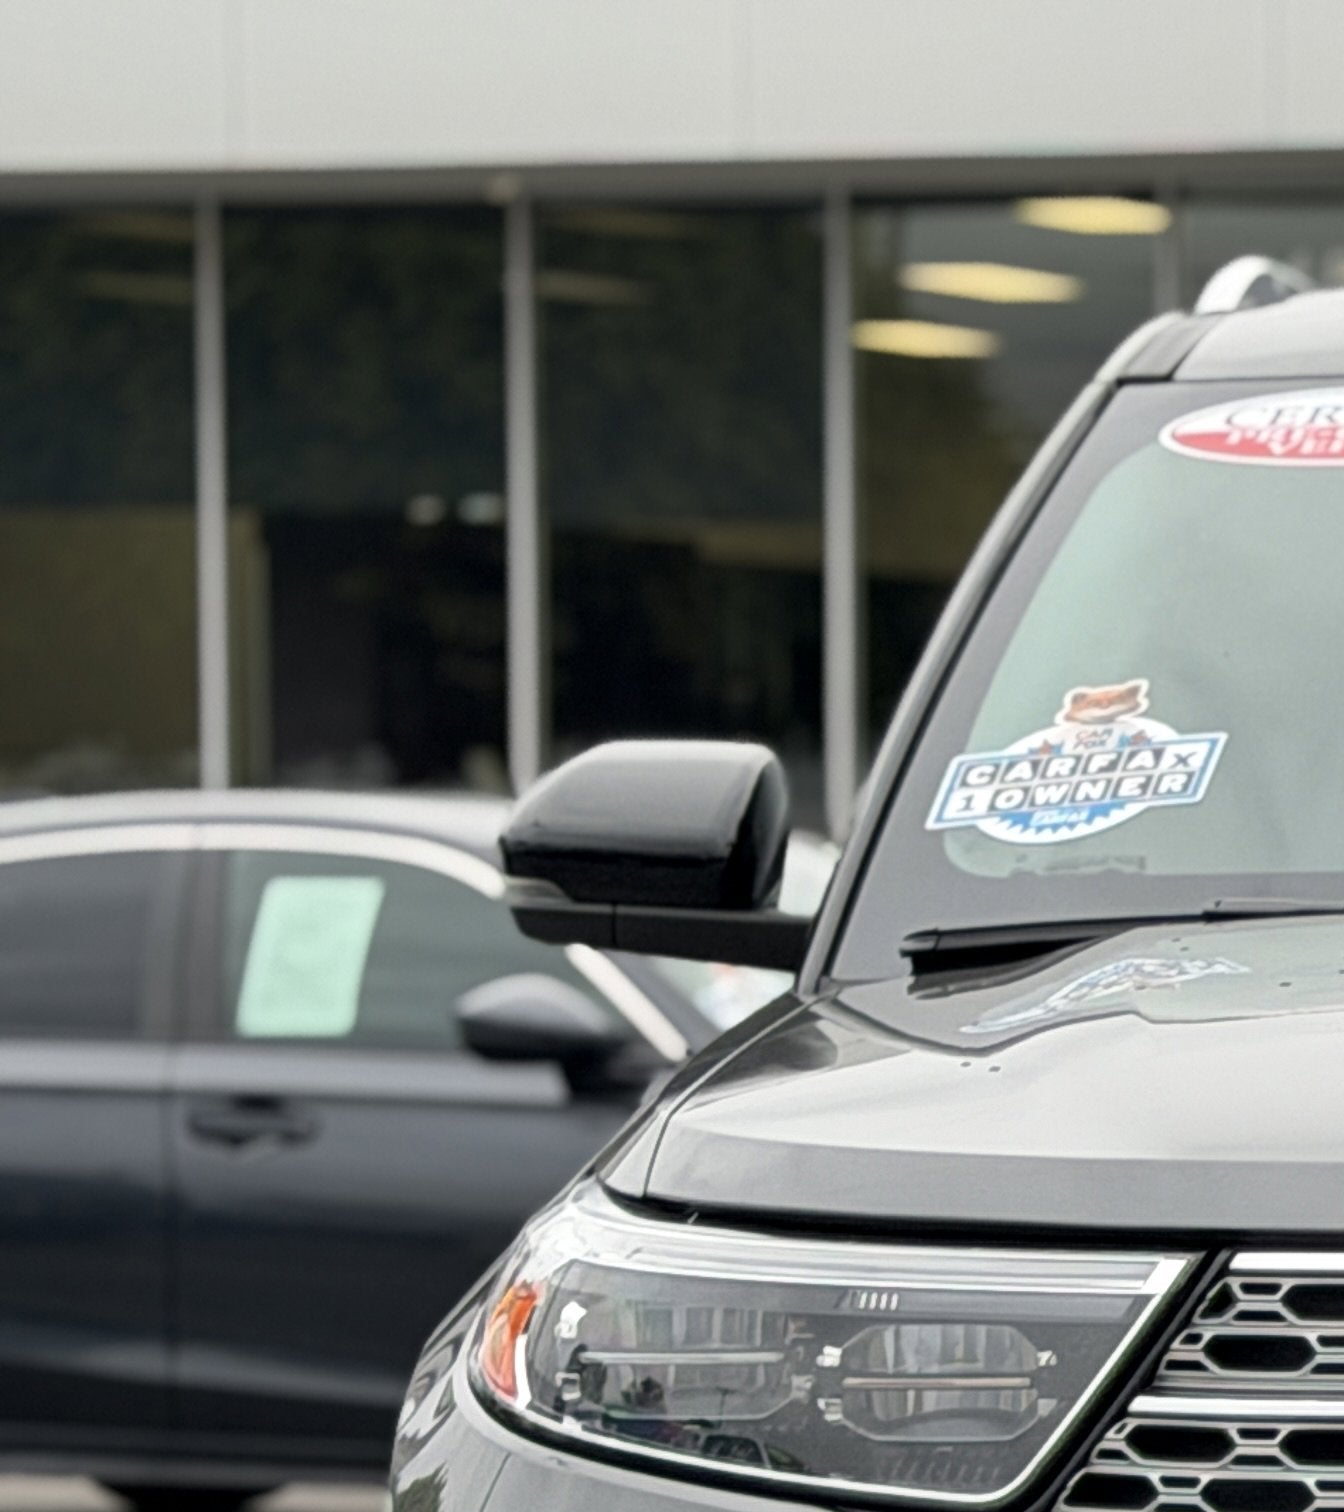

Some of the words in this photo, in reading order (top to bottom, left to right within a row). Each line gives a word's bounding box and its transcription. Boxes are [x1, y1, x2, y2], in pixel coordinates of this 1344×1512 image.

[964, 750, 1198, 787] CARFAX
[957, 793, 977, 813] 1
[993, 772, 1193, 810] OWNER
